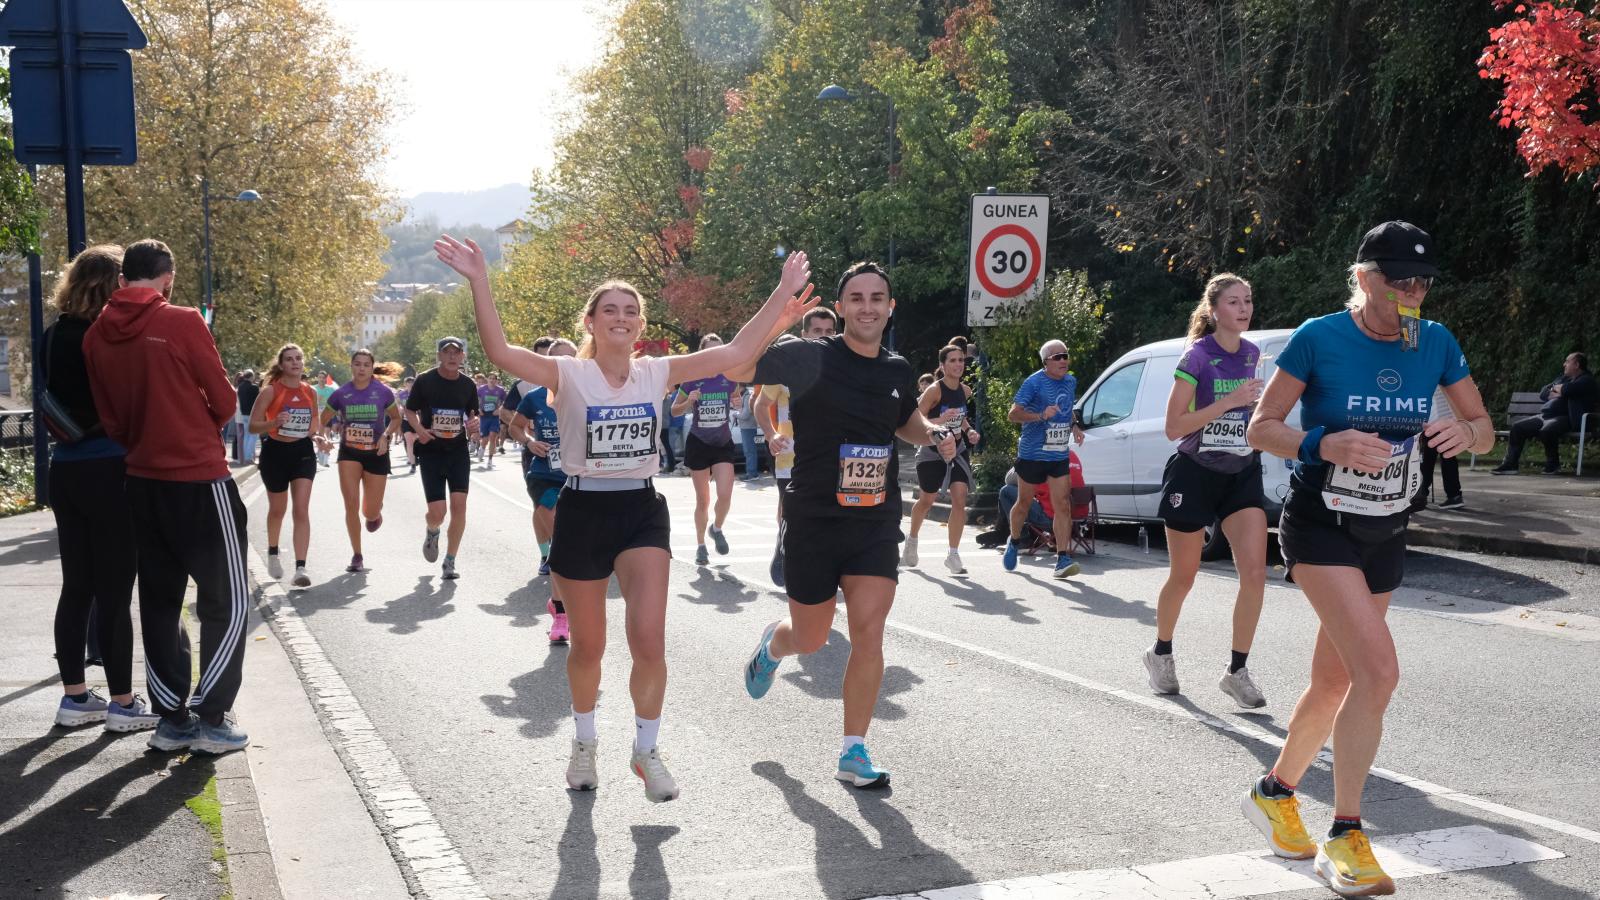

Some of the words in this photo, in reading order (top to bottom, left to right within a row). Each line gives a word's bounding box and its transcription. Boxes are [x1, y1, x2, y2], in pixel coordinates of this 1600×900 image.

[983, 204, 1038, 218] GUNEA
[991, 250, 1027, 274] 30
[700, 407, 725, 415] 20827
[1347, 395, 1428, 413] FRIME
[289, 415, 310, 424] 7282
[347, 429, 373, 438] 12144
[594, 421, 651, 442] 17795
[1204, 422, 1244, 438] 20946
[612, 443, 634, 451] BERTA
